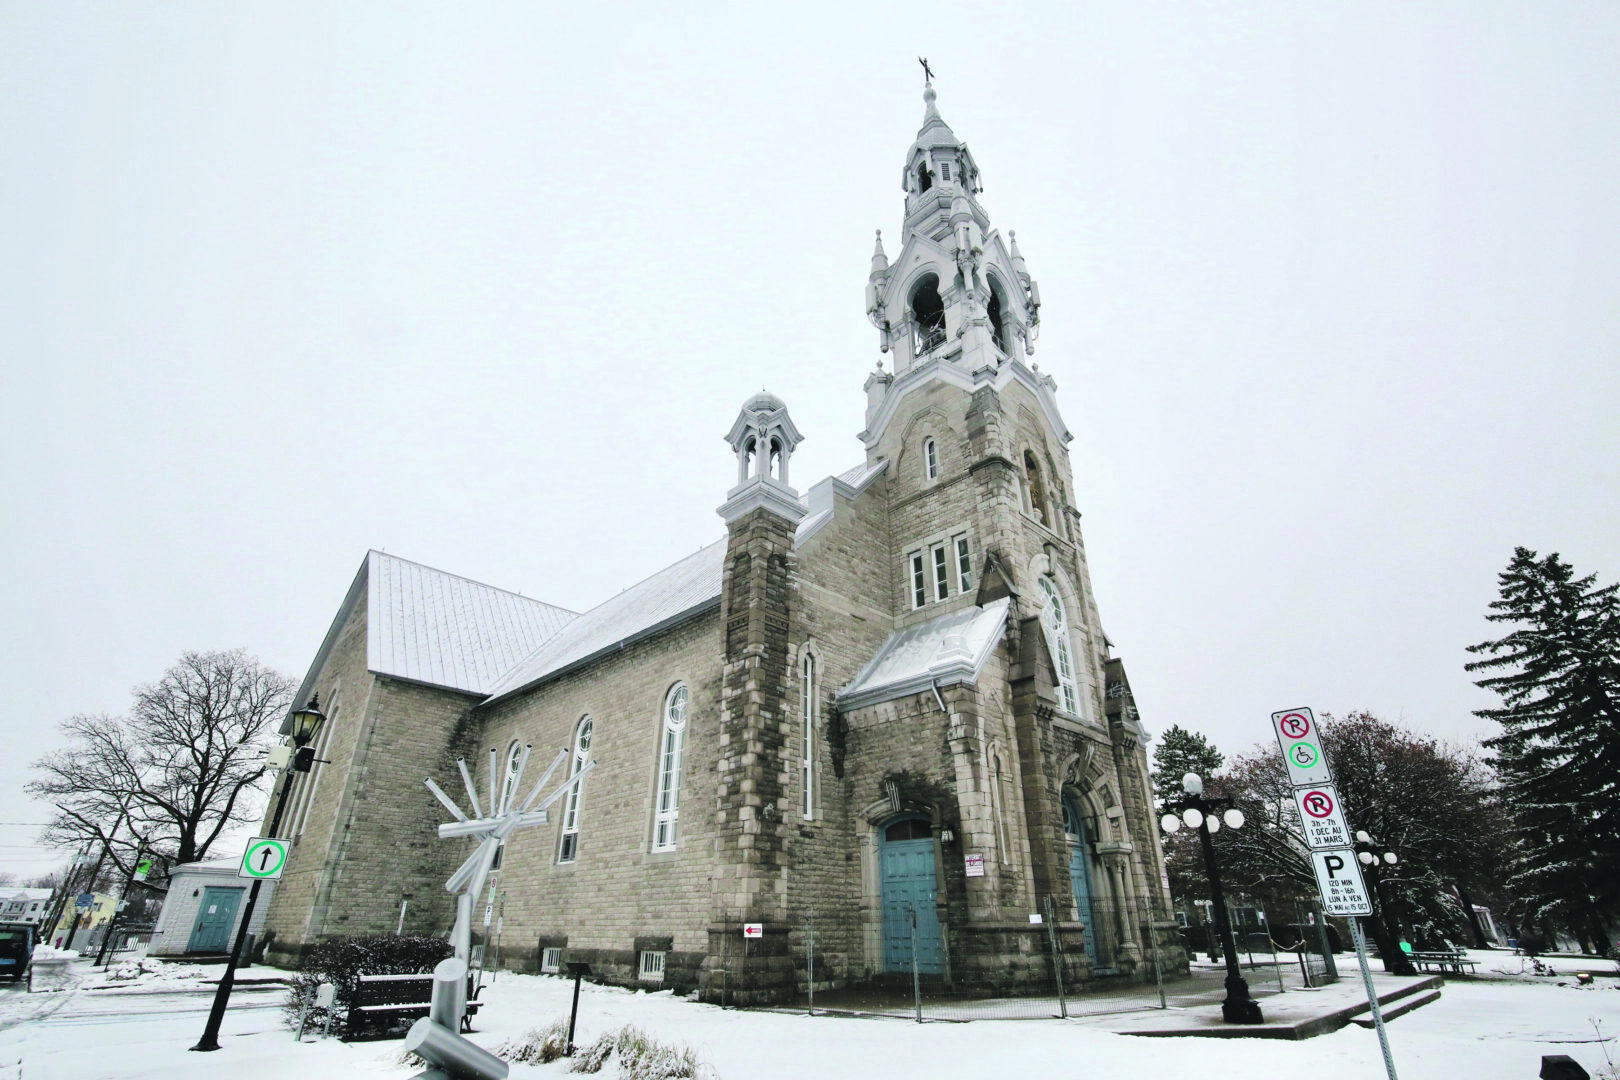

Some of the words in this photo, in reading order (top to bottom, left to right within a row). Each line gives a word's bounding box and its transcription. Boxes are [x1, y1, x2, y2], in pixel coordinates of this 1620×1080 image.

[1289, 719, 1300, 733] P
[1310, 797, 1324, 812] P
[1324, 836, 1344, 844] MARS
[1324, 856, 1344, 878] P
